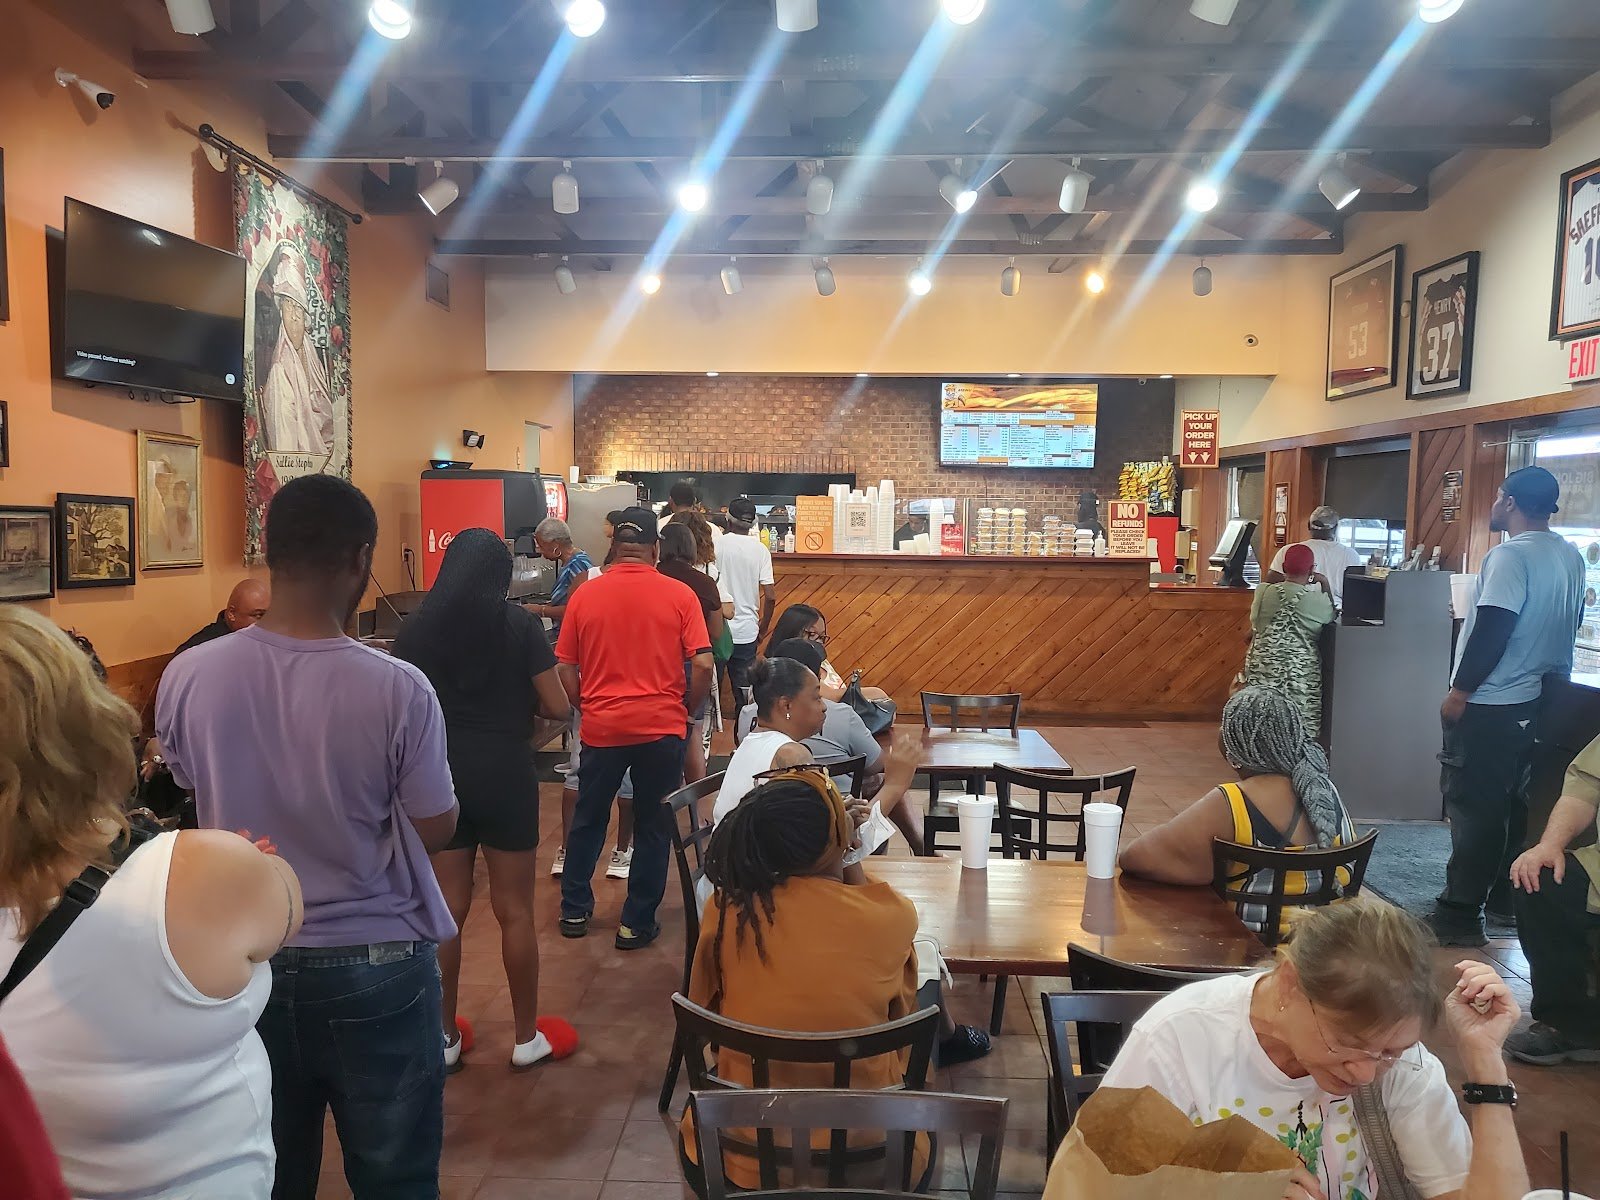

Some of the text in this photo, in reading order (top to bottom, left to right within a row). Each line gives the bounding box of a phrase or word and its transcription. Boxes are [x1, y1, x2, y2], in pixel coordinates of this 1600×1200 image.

[1349, 321, 1369, 360] 53
[76, 350, 88, 358] Video
[1422, 321, 1456, 383] 37
[1568, 337, 1600, 379] EXIT
[1184, 413, 1218, 421] PICK UP
[1188, 422, 1213, 430] YOUR
[1184, 431, 1215, 439] ORDER
[1188, 440, 1212, 449] HERE
[276, 455, 294, 468] Sallie
[1117, 503, 1139, 519] NO
[1112, 519, 1144, 528] REFUNDS
